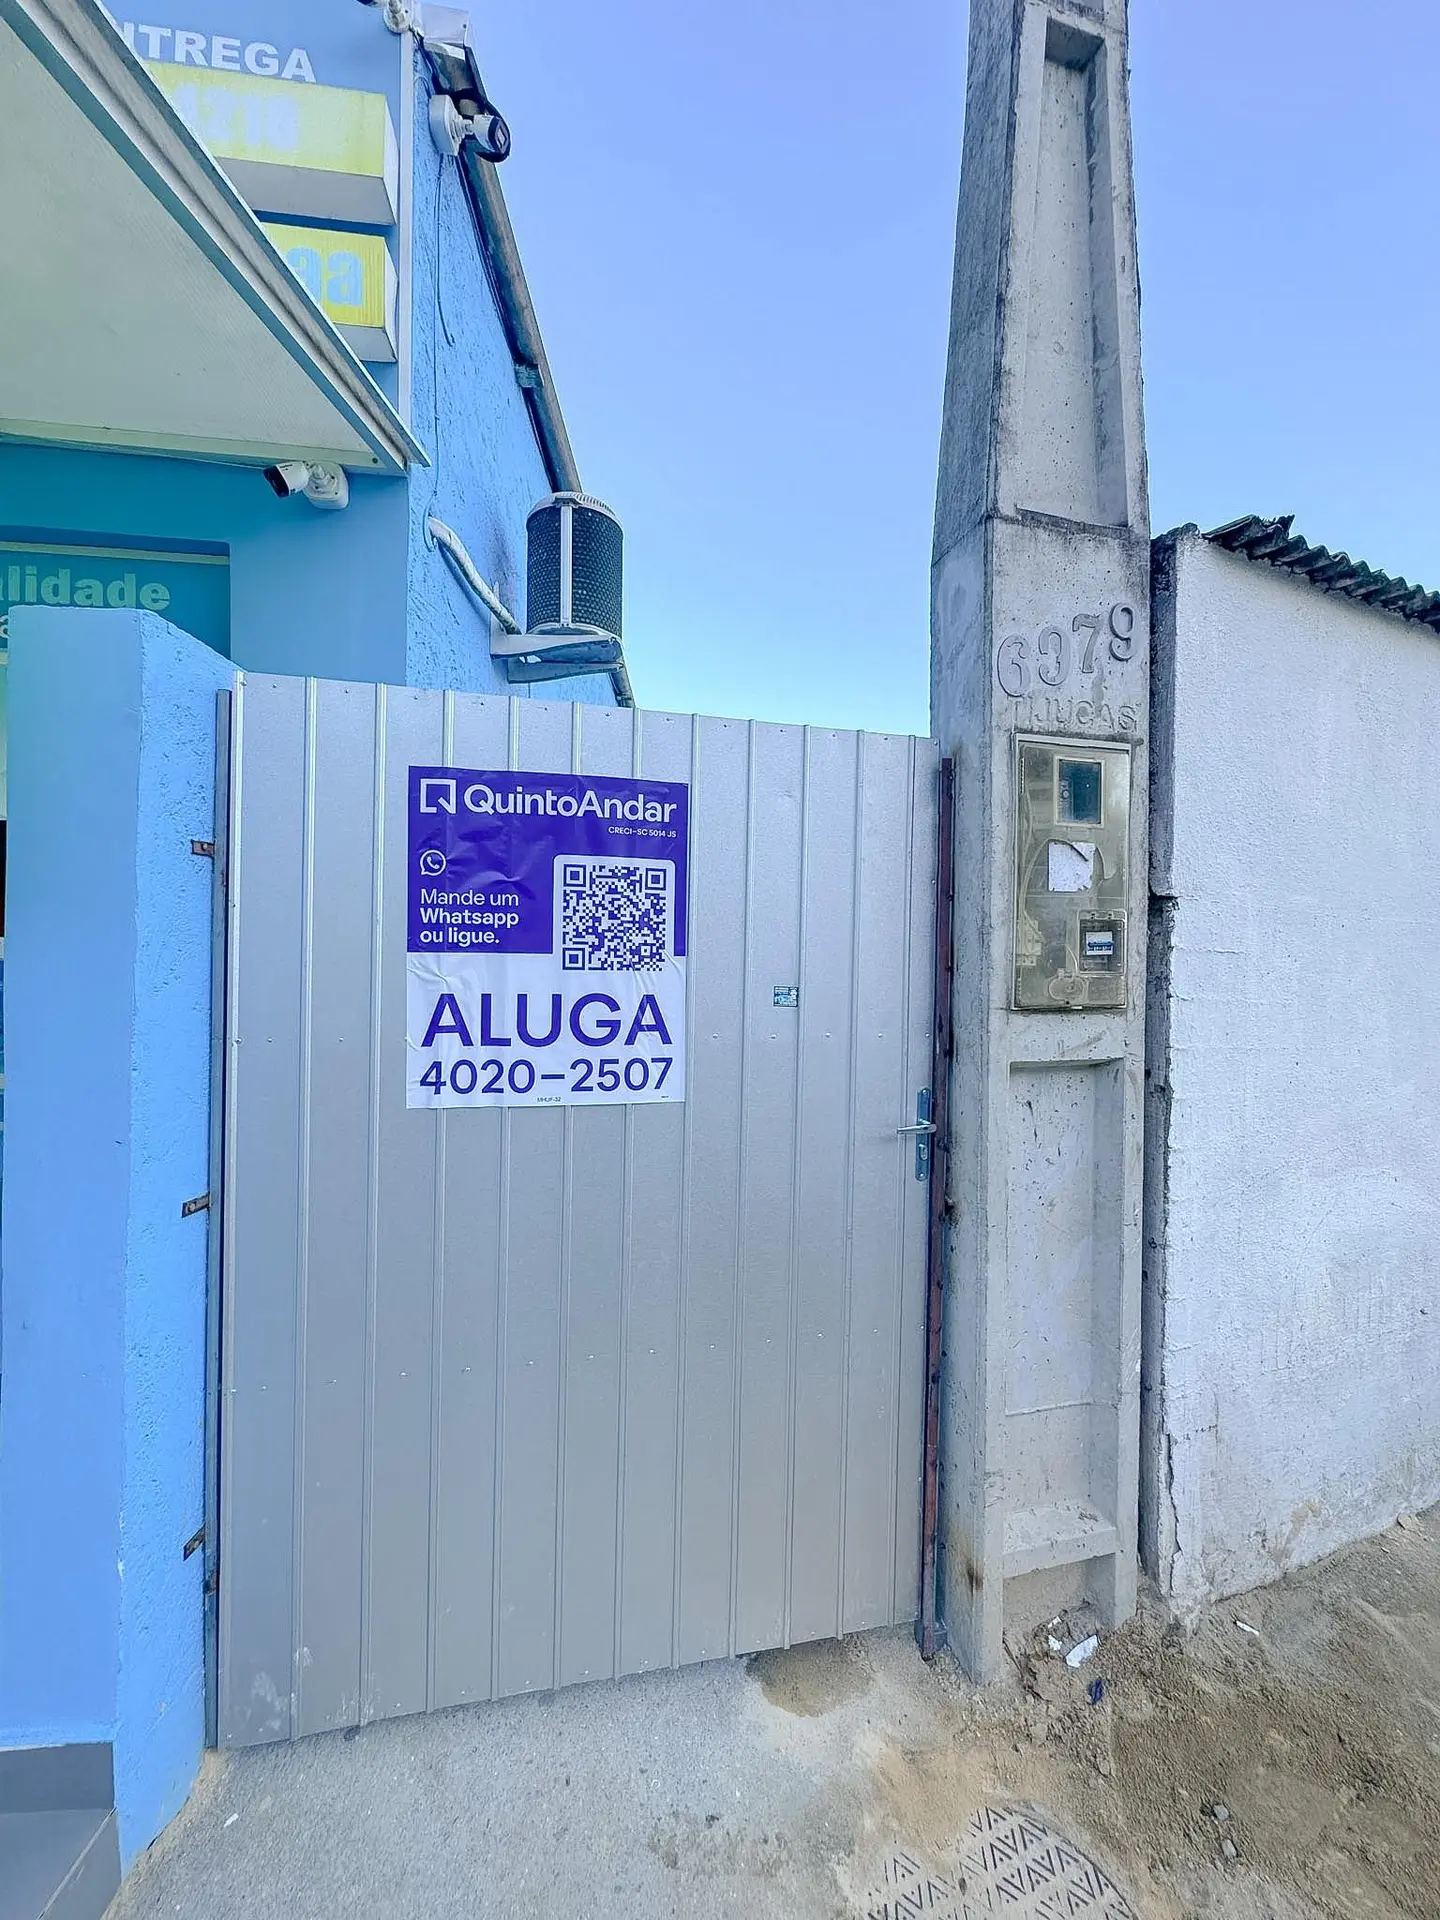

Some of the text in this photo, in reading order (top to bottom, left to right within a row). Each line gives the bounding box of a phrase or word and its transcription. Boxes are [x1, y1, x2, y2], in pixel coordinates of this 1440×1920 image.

[0, 565, 170, 611] lidade
[463, 784, 677, 823] QuintoAndar
[608, 826, 677, 838] CRECI-SC 5014 JS
[421, 888, 519, 906] Mande um
[420, 907, 519, 928] Whatsapp
[420, 926, 500, 947] ou ligue.
[421, 992, 673, 1048] ALUGA
[419, 1056, 674, 1096] 4020-2507
